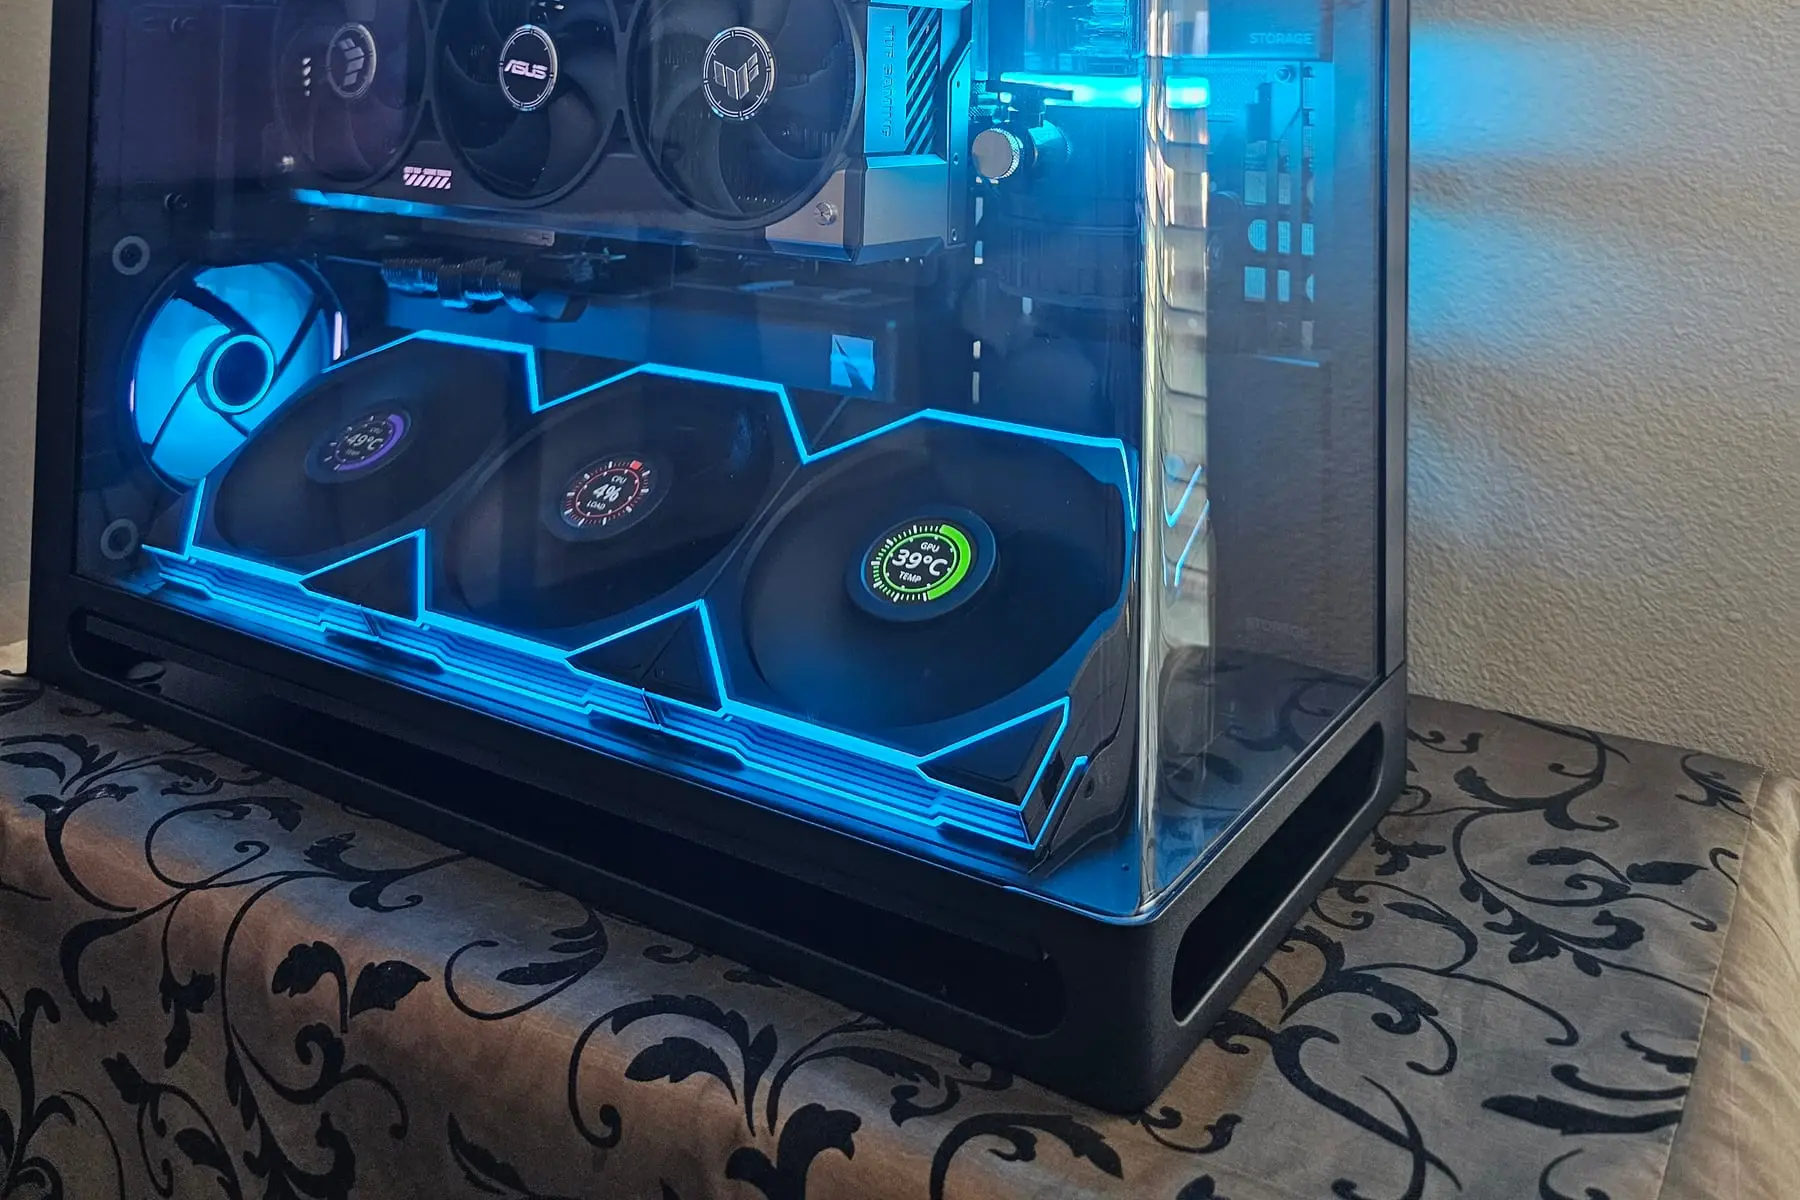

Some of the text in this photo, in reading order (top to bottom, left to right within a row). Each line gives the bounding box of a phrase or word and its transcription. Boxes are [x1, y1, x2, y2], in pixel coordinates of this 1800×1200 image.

[1249, 32, 1314, 45] STORAGE
[504, 59, 548, 80] ASUS
[592, 483, 622, 503] 4%
[920, 541, 941, 553] GPU
[891, 549, 948, 577] 39°C
[899, 570, 922, 584] TEMP
